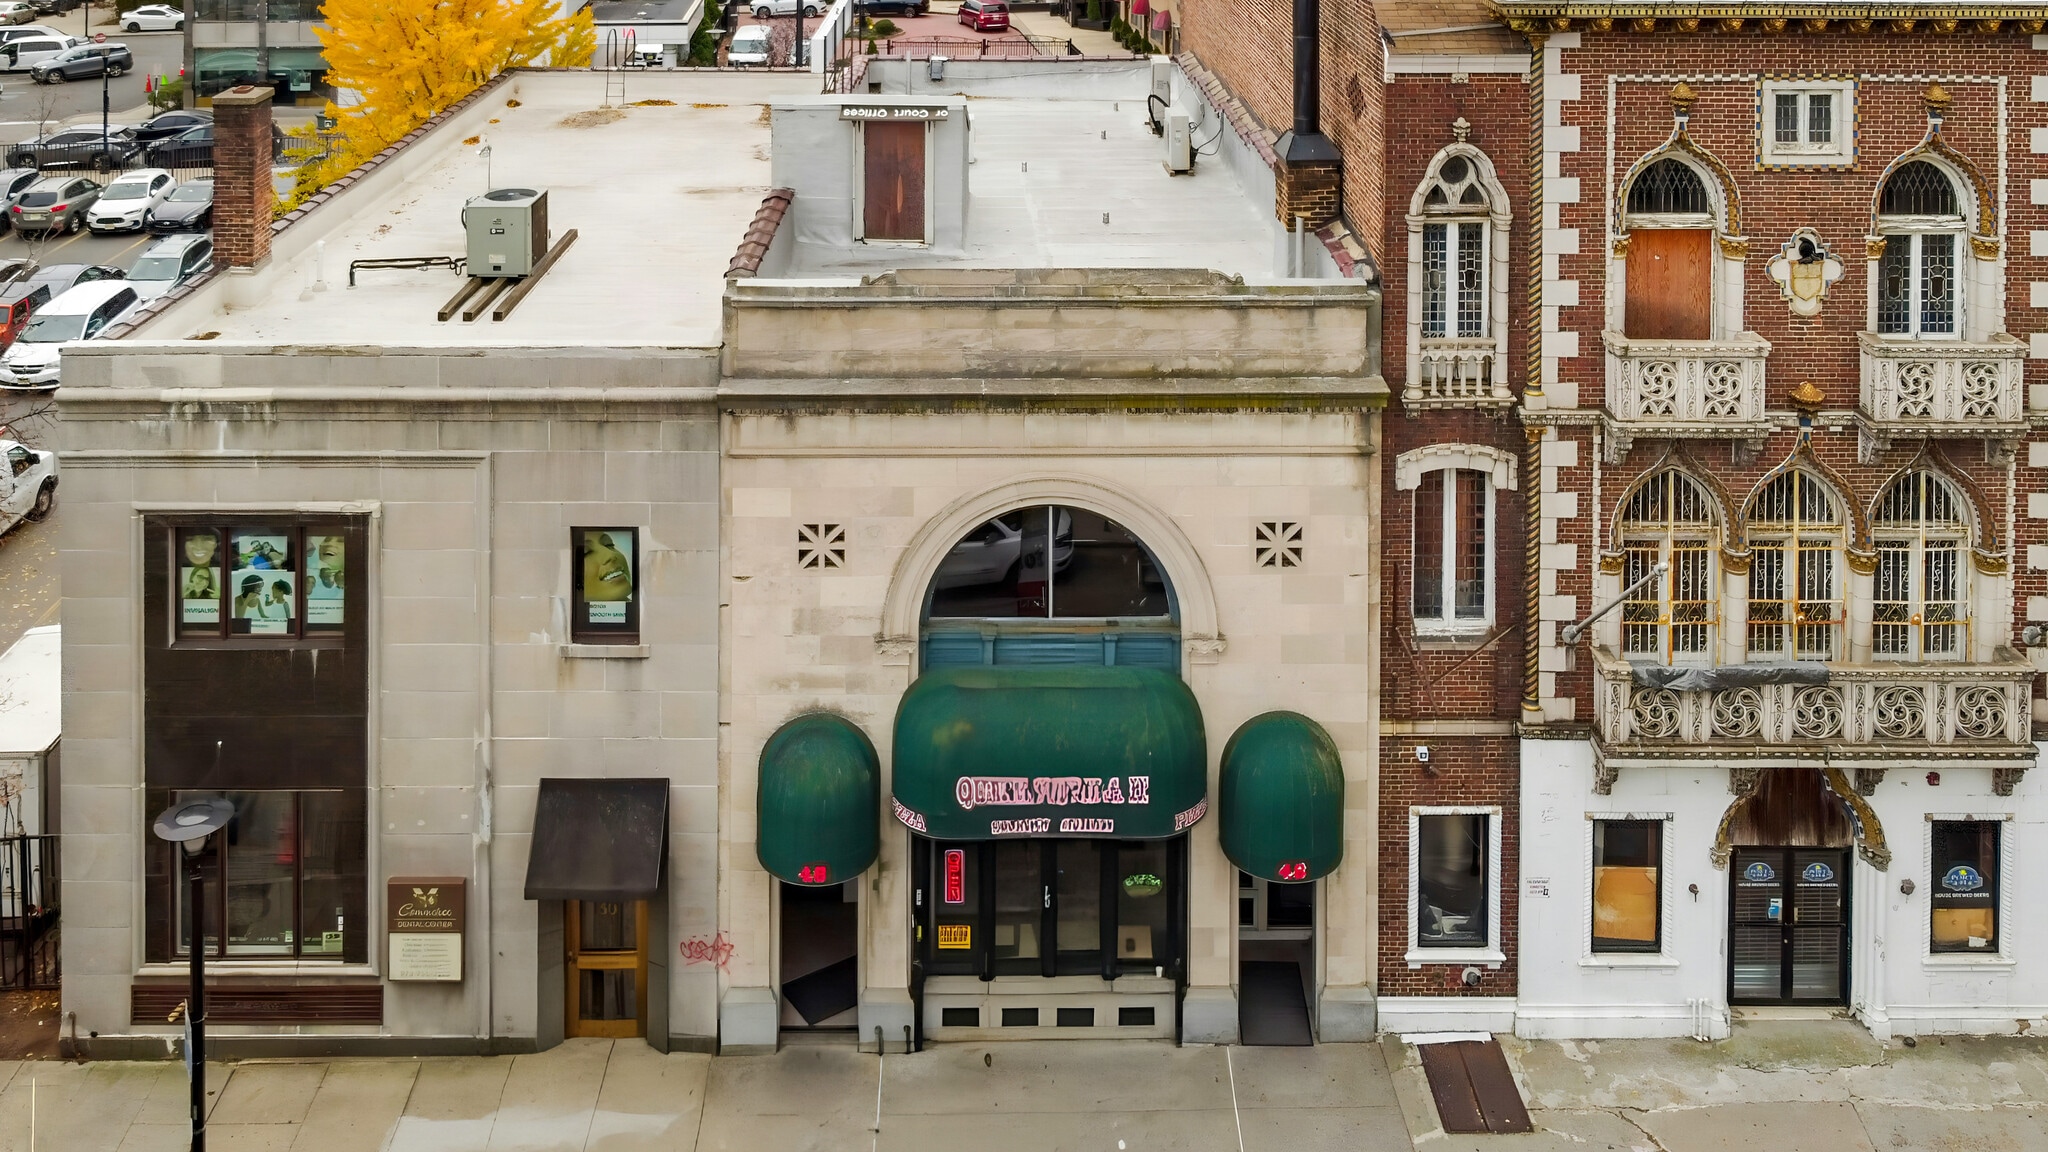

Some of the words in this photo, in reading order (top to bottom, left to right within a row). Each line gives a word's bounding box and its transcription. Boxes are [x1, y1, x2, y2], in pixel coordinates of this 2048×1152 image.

[843, 108, 888, 118] Offices
[894, 108, 929, 118] Court
[947, 851, 961, 901] OPEN
